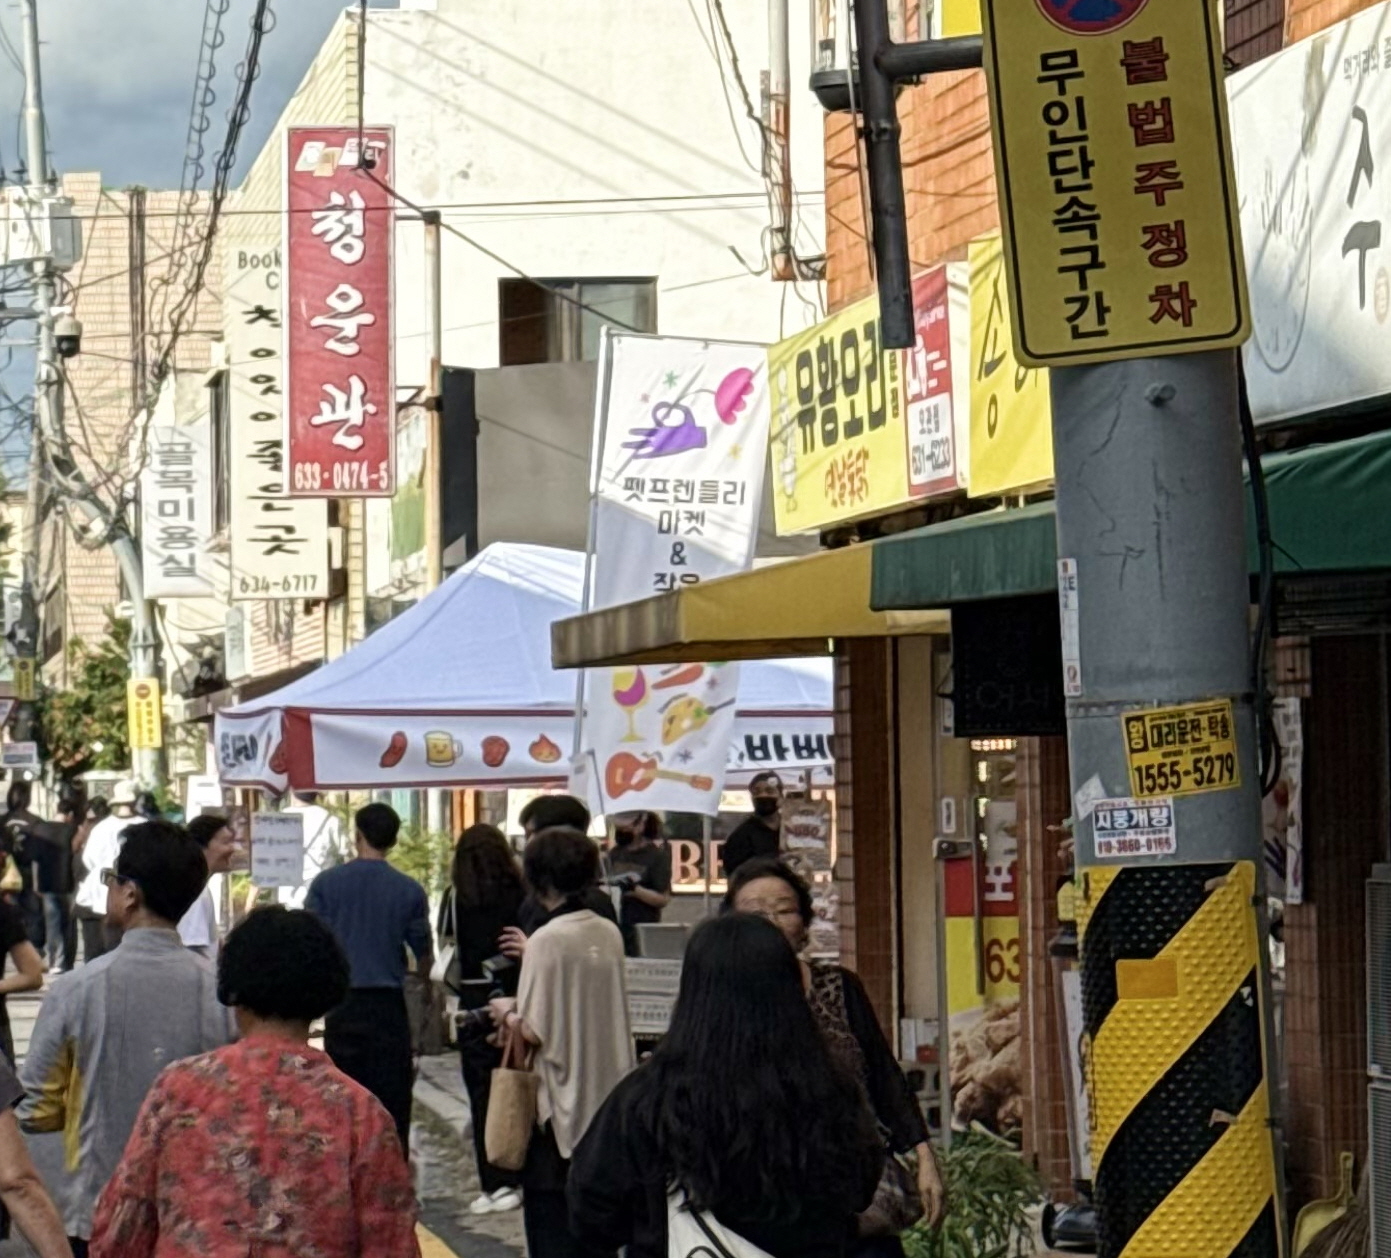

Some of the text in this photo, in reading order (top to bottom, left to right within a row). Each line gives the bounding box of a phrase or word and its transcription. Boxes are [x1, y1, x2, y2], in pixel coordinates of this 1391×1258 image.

[1037, 49, 1111, 341] 무인단속구간
[1121, 36, 1197, 327] 불법주정차
[795, 319, 887, 455] 유황오리
[622, 476, 746, 506] 펫프렌들리
[154, 442, 198, 578] 골목미용실
[657, 509, 706, 536] 마켓
[670, 541, 688, 566] &
[240, 575, 318, 594] 634-6717
[1134, 753, 1235, 794] 1555-5279
[1096, 805, 1170, 830] 지붕개량
